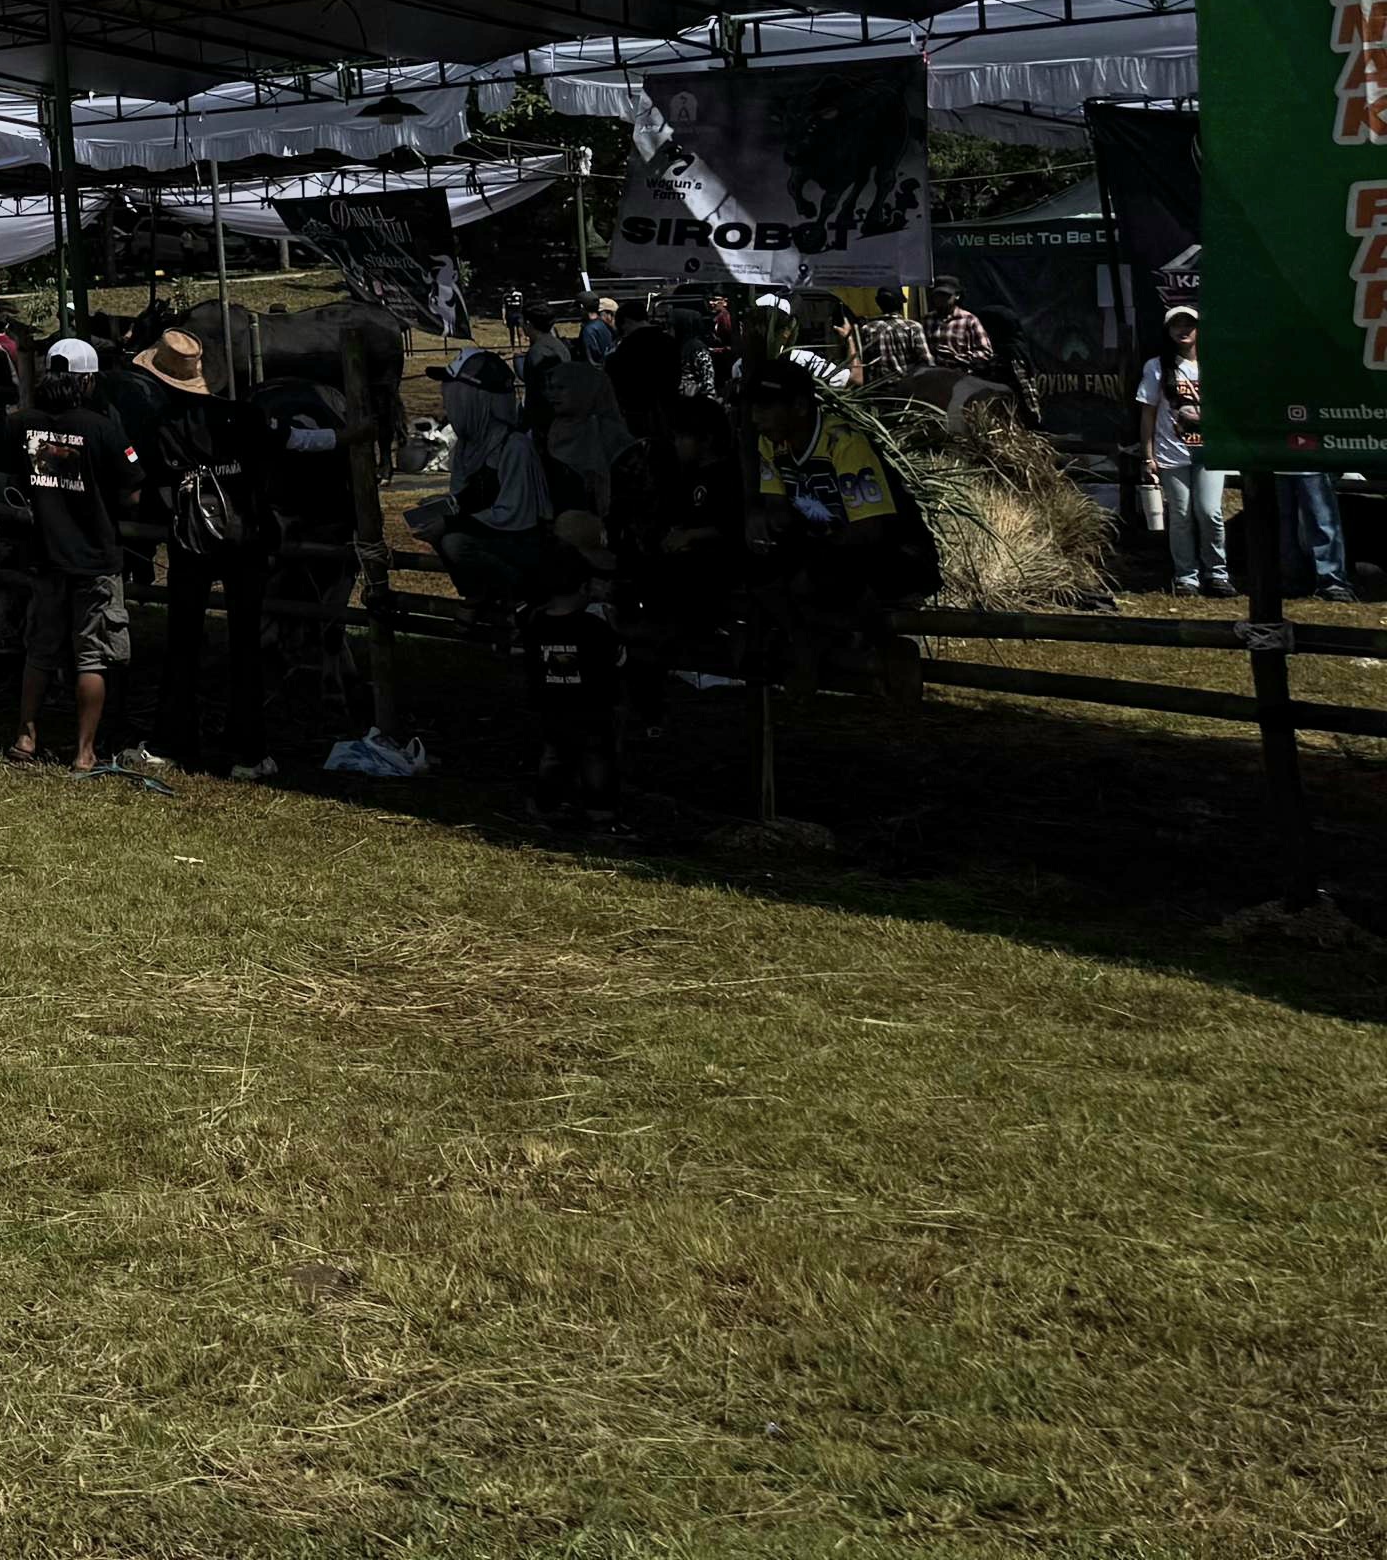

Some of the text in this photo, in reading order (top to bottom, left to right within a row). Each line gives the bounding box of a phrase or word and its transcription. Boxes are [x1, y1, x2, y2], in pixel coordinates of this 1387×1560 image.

[621, 216, 856, 254] SIROBOT
[956, 233, 985, 247] We
[988, 232, 1033, 247] Exist
[1037, 231, 1062, 246] To
[1066, 230, 1091, 245] Be
[1035, 373, 1079, 397] OVUM
[30, 473, 85, 492] DARMA UTAMA
[839, 467, 883, 508] 96
